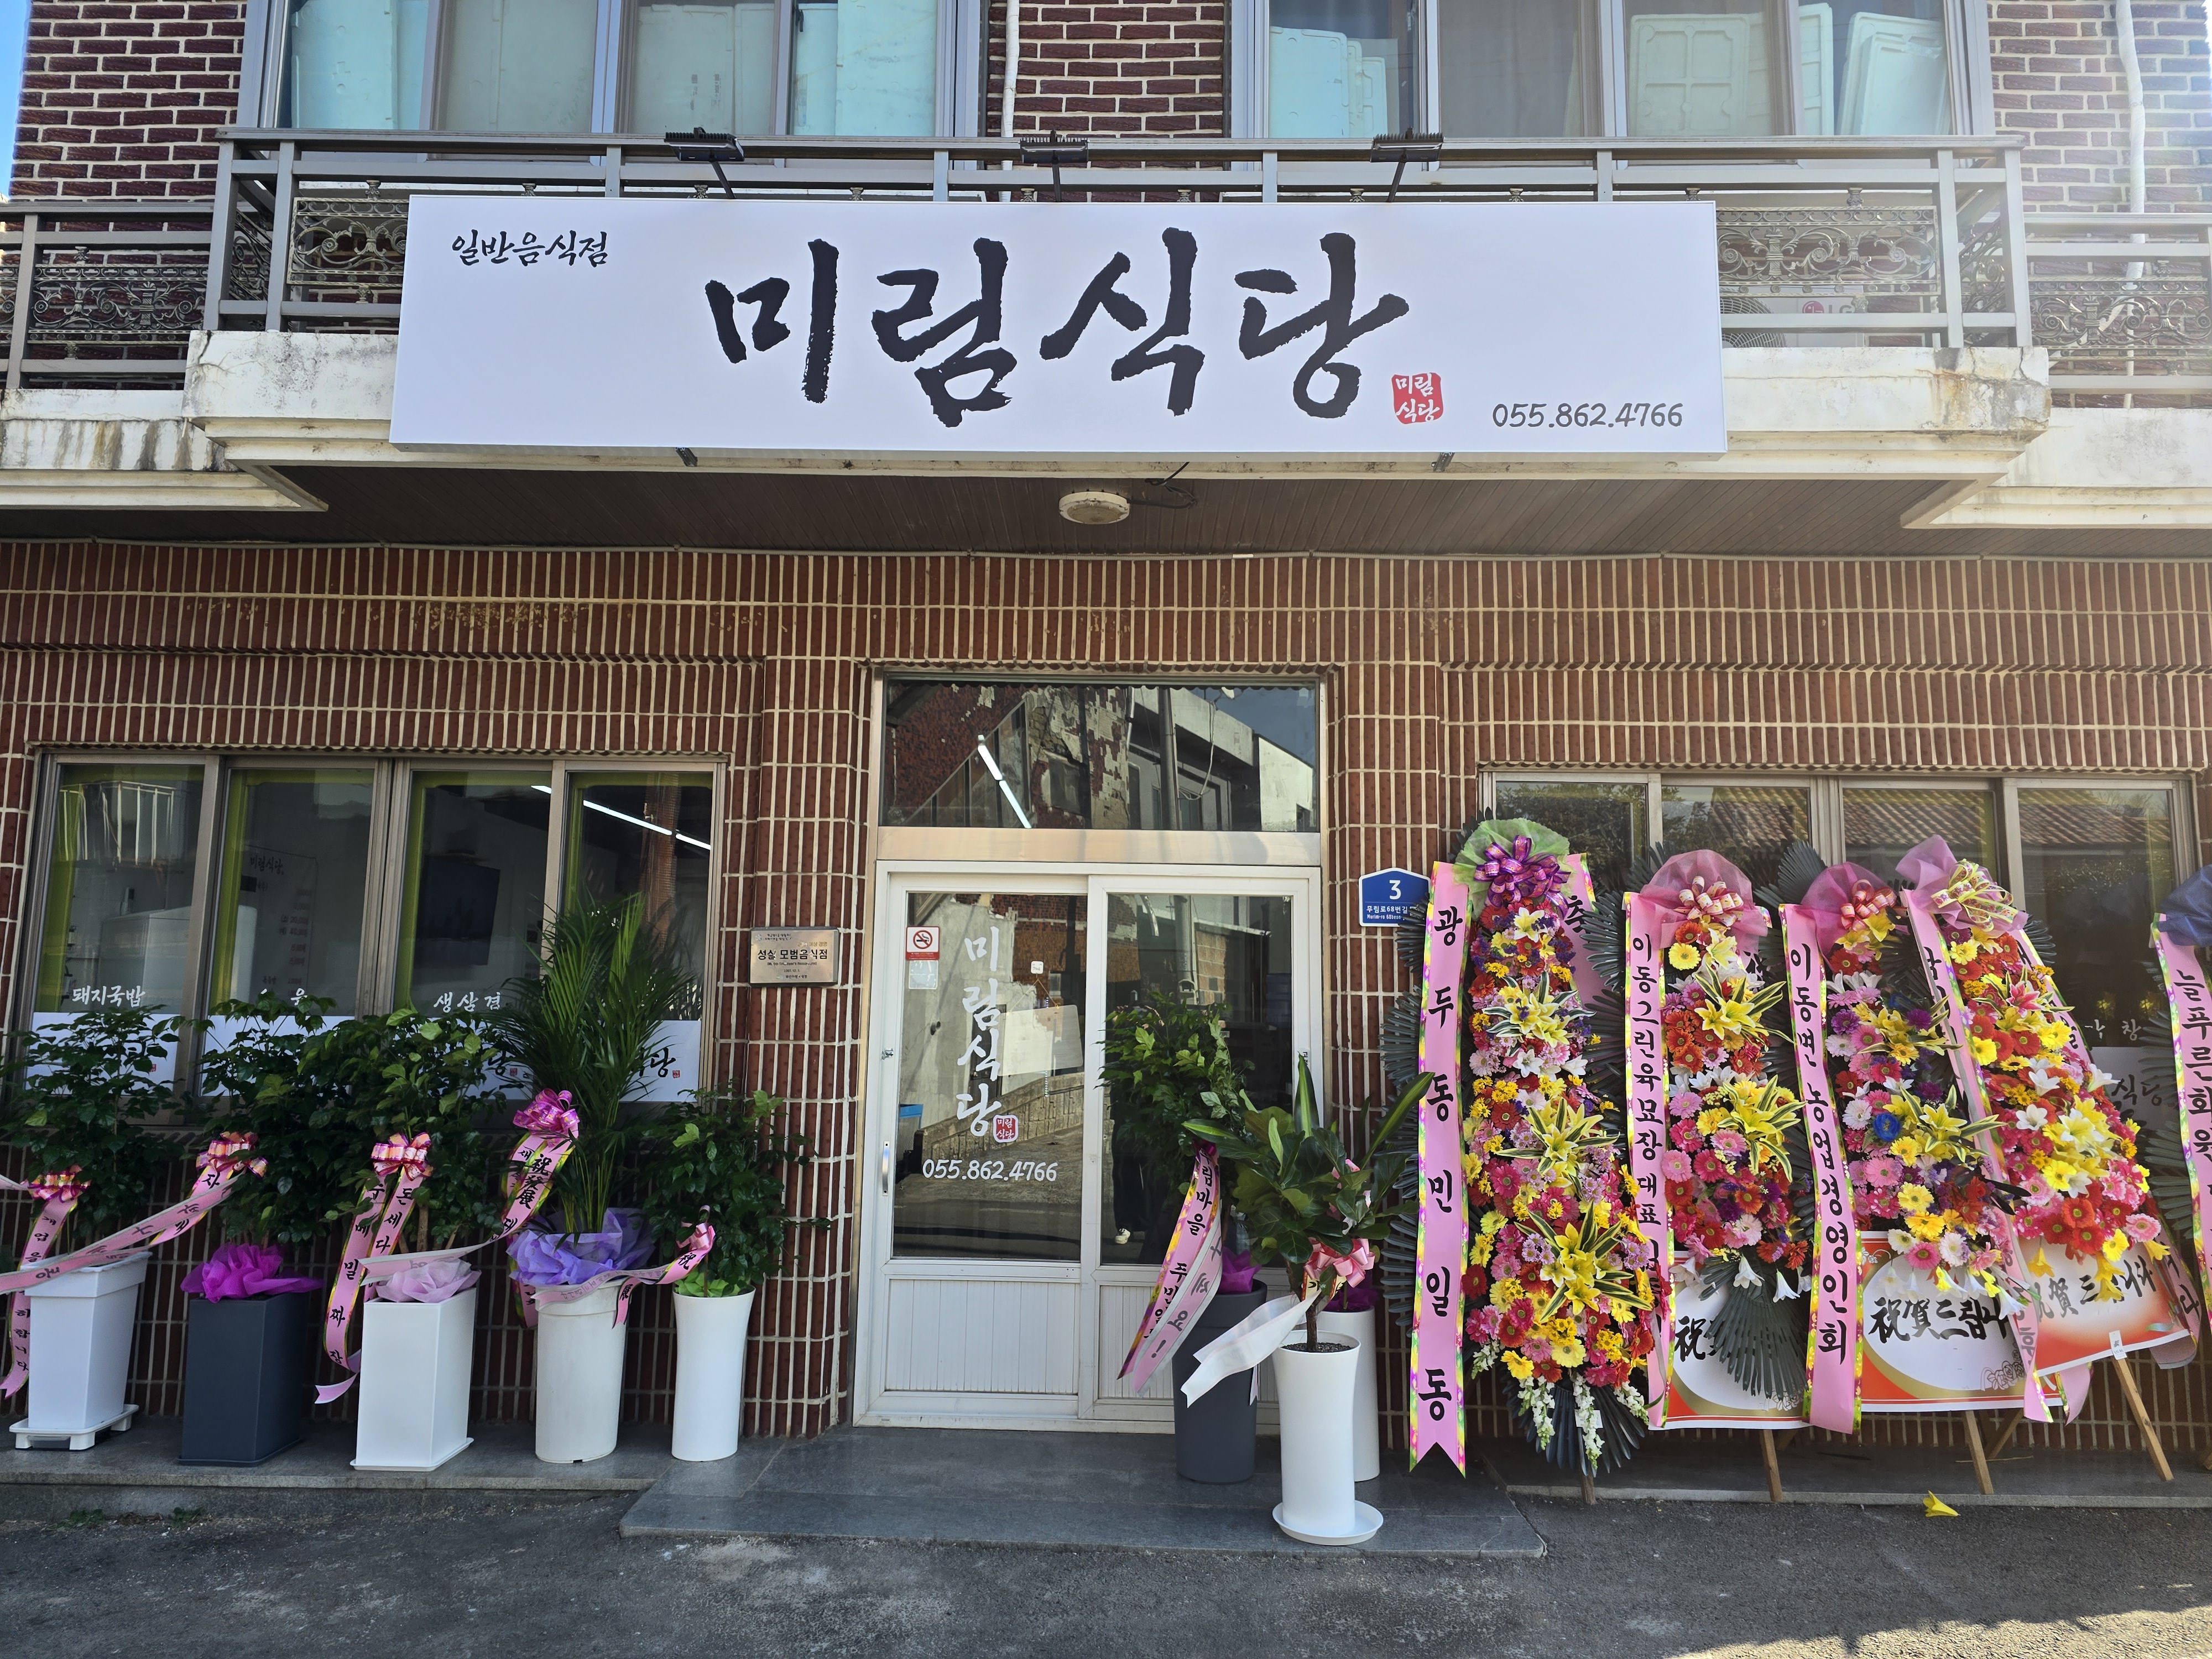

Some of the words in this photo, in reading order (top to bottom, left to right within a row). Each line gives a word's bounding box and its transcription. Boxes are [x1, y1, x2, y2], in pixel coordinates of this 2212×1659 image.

[450, 229, 609, 267] 일반음식점
[703, 227, 1410, 428] 미림식당
[1395, 373, 1433, 397] 미림
[1395, 398, 1440, 422] 식당
[1492, 402, 1683, 427] 055.862.4766
[1389, 879, 1401, 900] 3
[1366, 905, 1408, 914] 무림로68번길
[758, 949, 776, 960] 성실
[780, 948, 828, 960] 모범음식점
[72, 984, 145, 1007] 돼지국밥
[434, 992, 501, 1013] 생삼겹
[956, 926, 1002, 1136] 미림식당
[996, 1128, 1014, 1140] 식당
[998, 1118, 1013, 1129] 미림
[922, 1159, 1057, 1182] 055.862.4766
